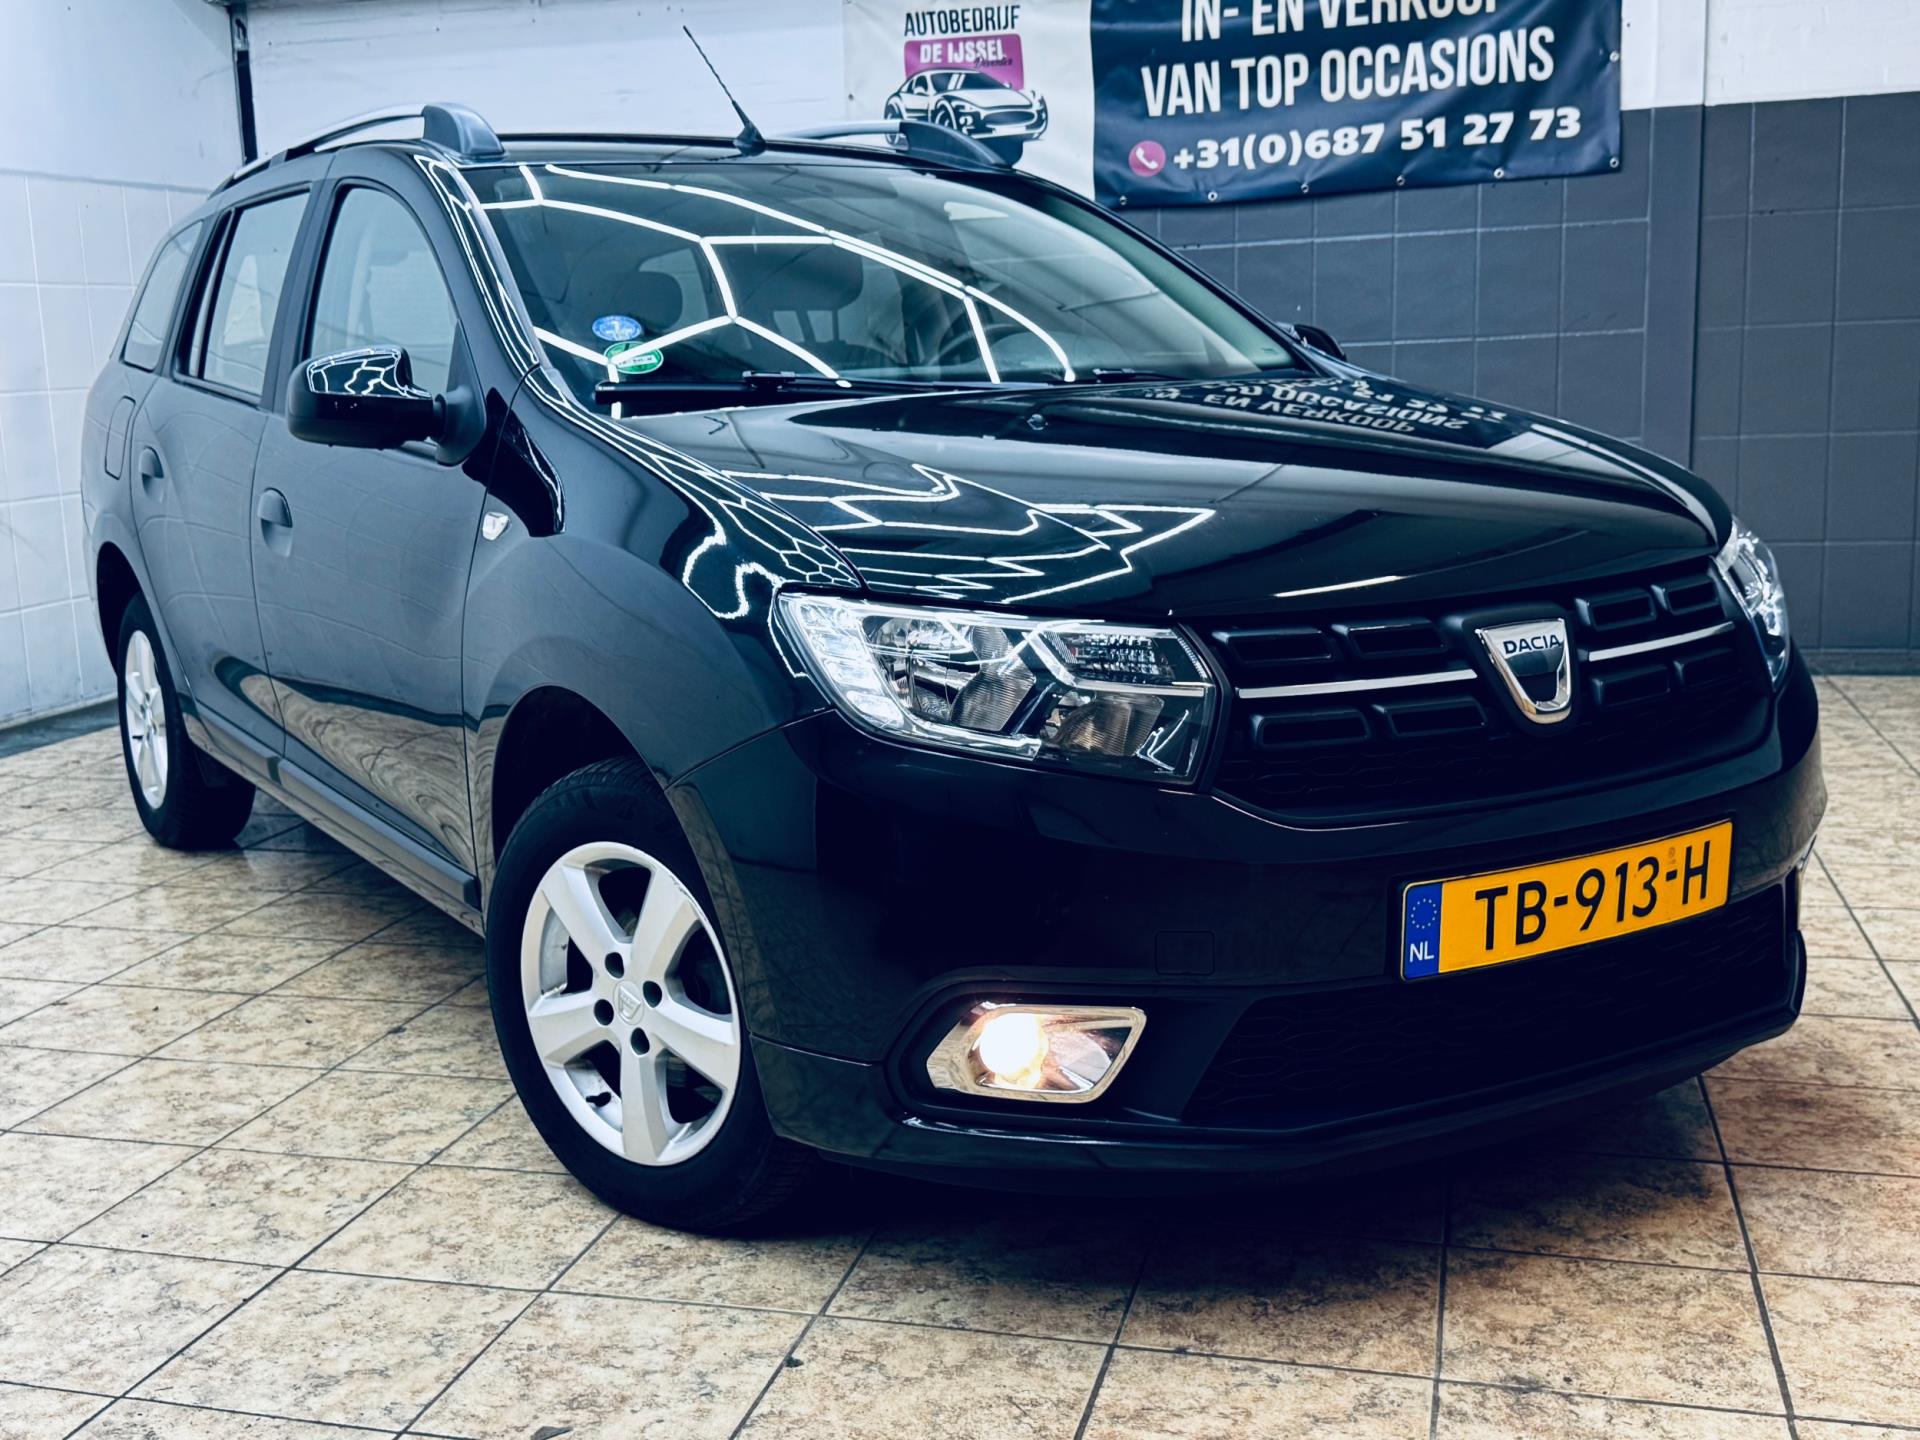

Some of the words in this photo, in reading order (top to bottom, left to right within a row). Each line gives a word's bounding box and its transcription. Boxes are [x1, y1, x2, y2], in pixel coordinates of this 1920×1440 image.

[904, 5, 1021, 36] AUTOBEDRIJF
[1182, 0, 1239, 42] IN-
[1252, 0, 1304, 36] EN
[919, 44, 943, 63] DE
[947, 39, 1007, 63] IJSSEL
[1141, 60, 1221, 117] VAN
[1230, 54, 1309, 110] TOP
[1320, 26, 1555, 102] OCCASIONS
[1173, 123, 1385, 170] +31(0)687
[1400, 117, 1446, 150] 51
[1463, 112, 1514, 145] 27
[1529, 106, 1581, 141] 73
[1503, 635, 1561, 655] DACIA
[1474, 840, 1711, 951] TB-913-H
[1409, 941, 1434, 962] NL
